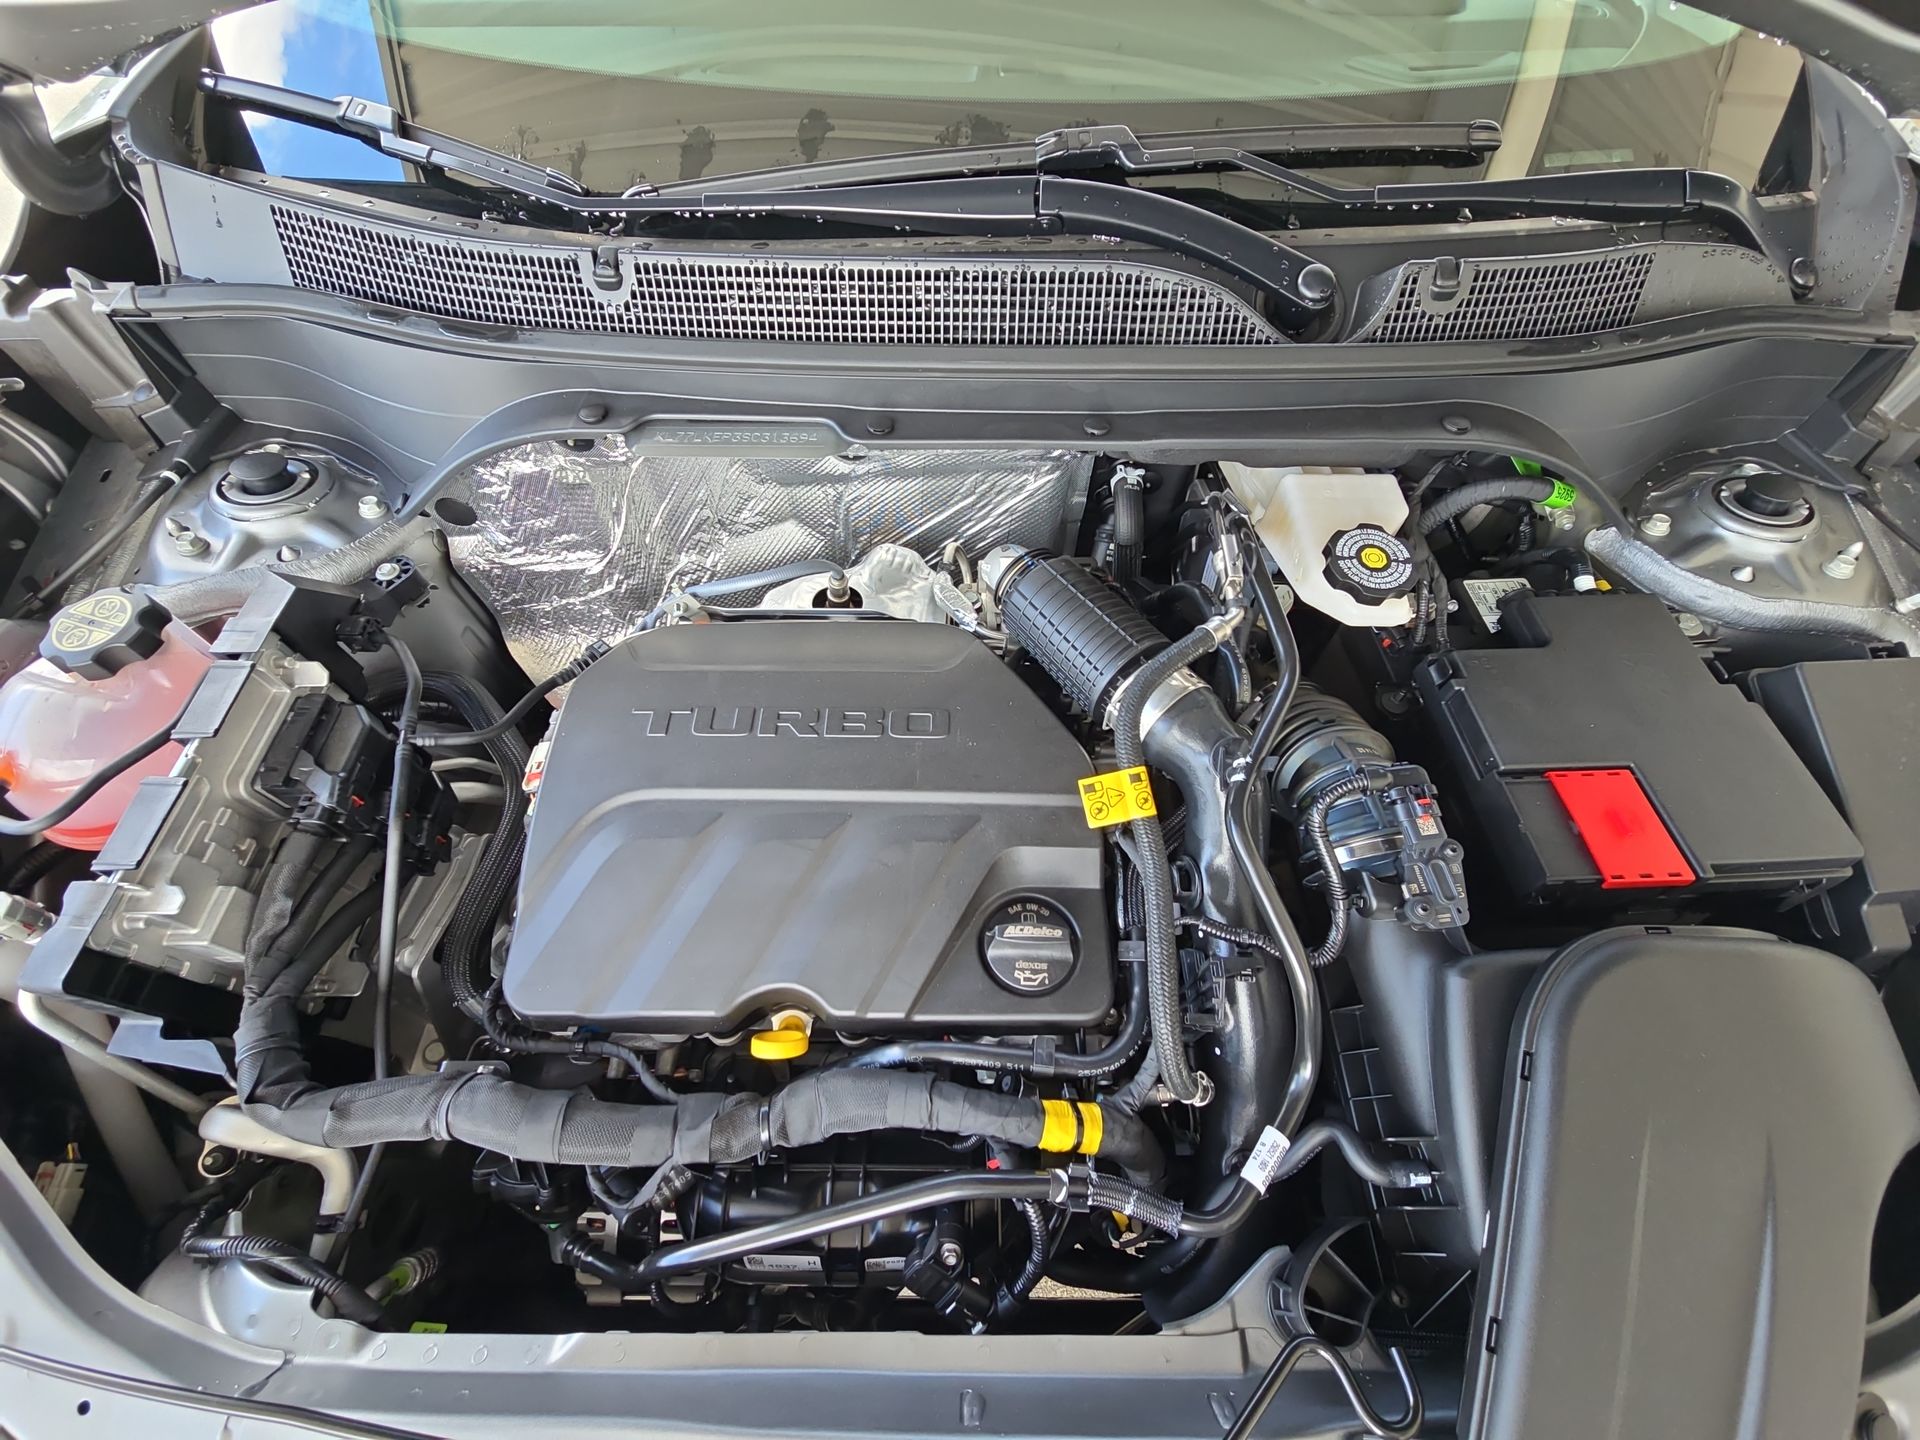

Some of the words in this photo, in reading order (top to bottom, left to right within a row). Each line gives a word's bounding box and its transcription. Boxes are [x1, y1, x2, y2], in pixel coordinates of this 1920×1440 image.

[632, 707, 950, 738] TURBO
[1008, 903, 1023, 914] SAE
[1003, 925, 1063, 937] ACDelco
[1015, 960, 1048, 969] dexos
